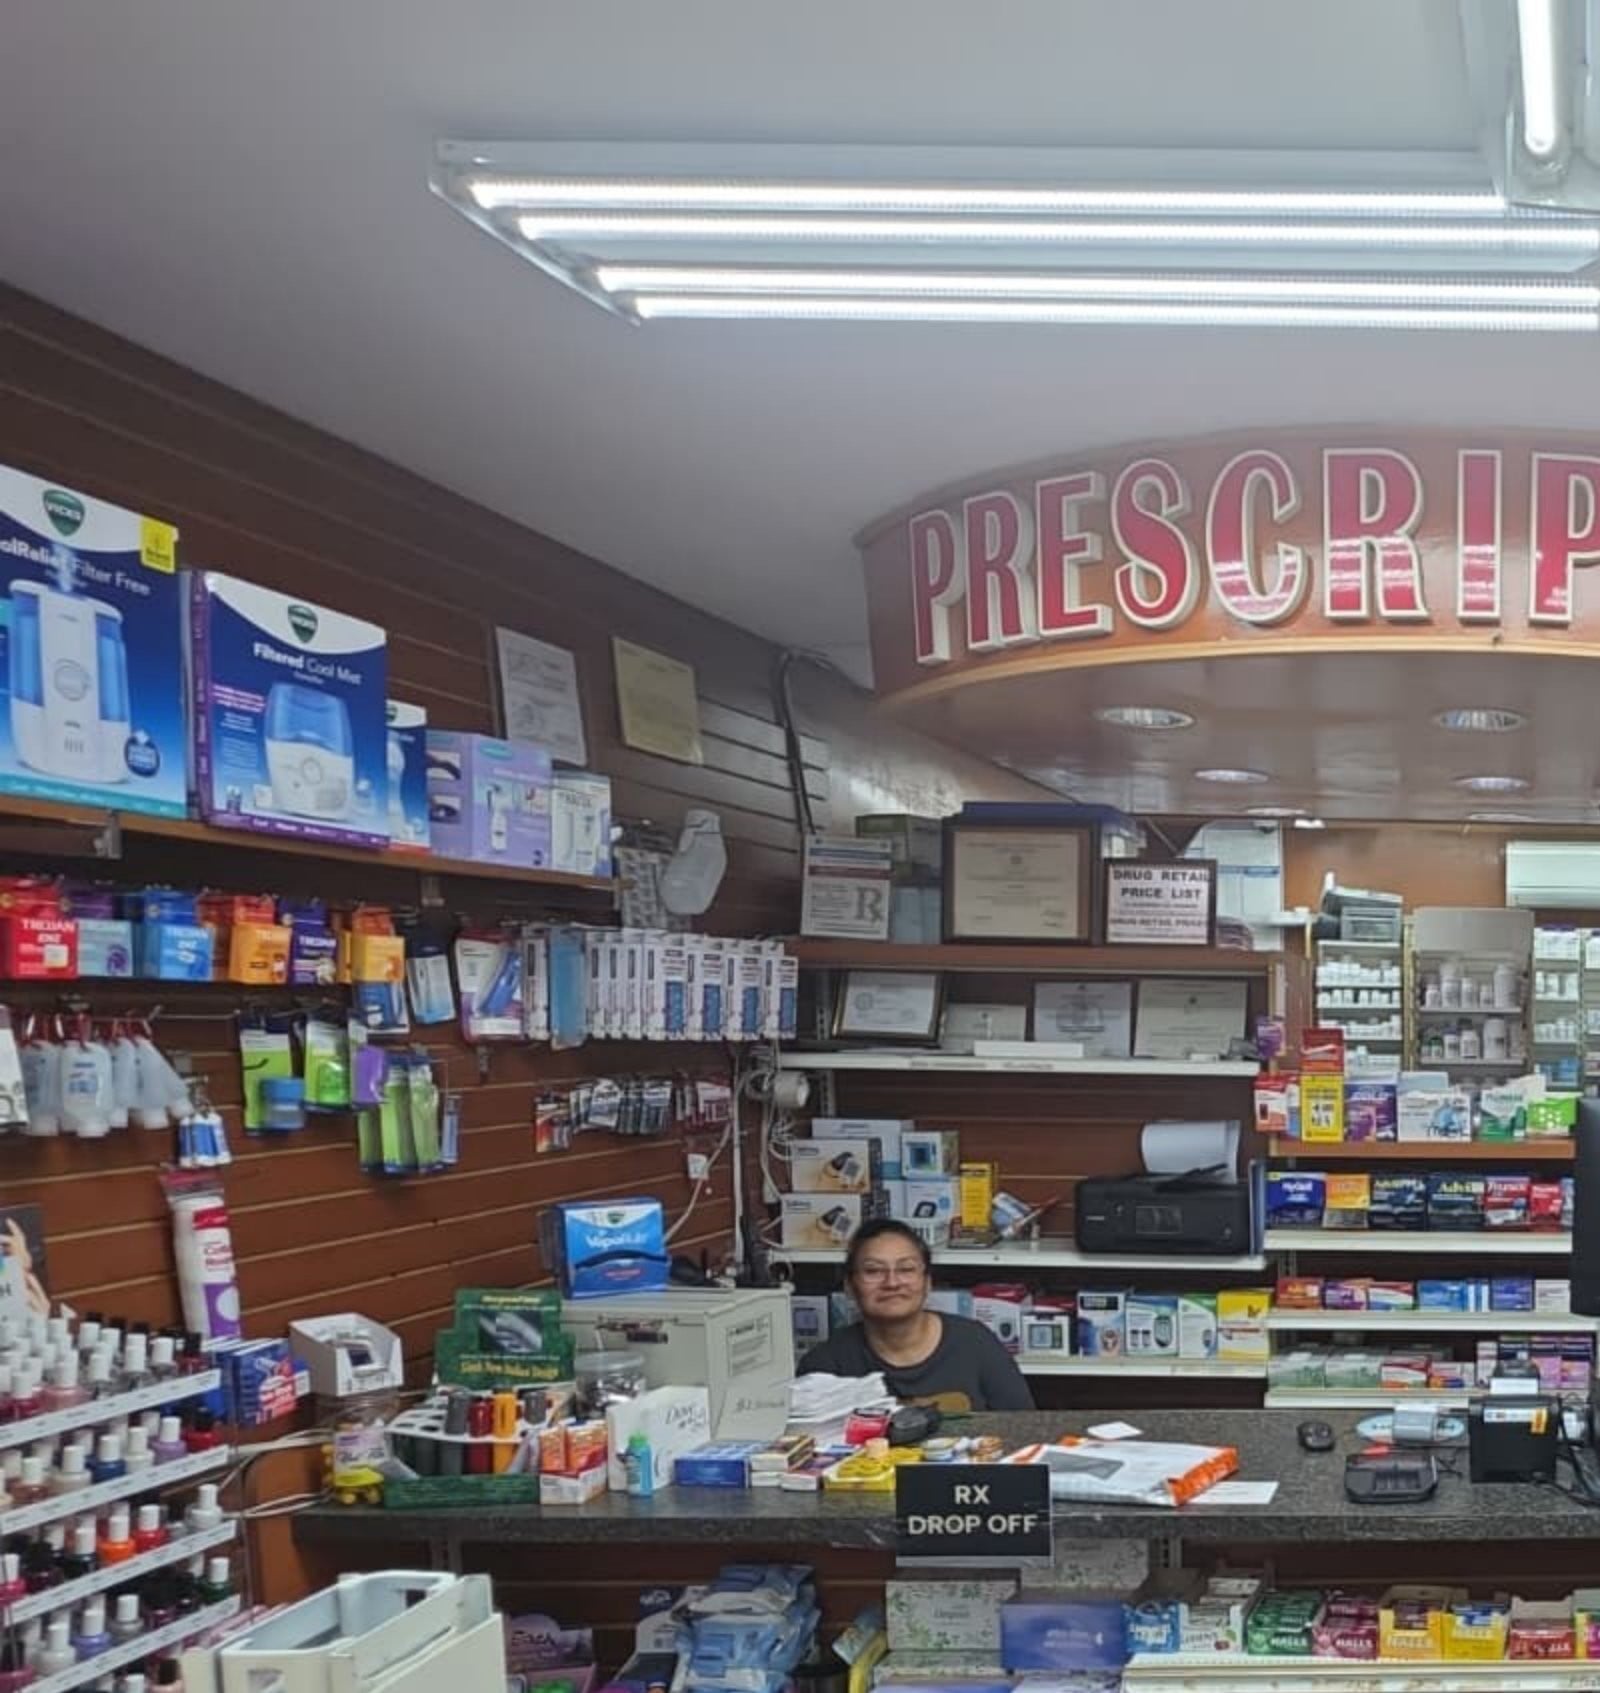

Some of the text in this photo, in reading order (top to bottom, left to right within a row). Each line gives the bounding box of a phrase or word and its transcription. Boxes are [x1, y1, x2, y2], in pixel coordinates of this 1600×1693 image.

[253, 641, 304, 669] Filtered
[1113, 870, 1153, 881] DRUG
[1121, 887, 1202, 899] PRICE LIST
[954, 1485, 990, 1505] RX
[907, 1514, 1039, 1535] DROP OFF
